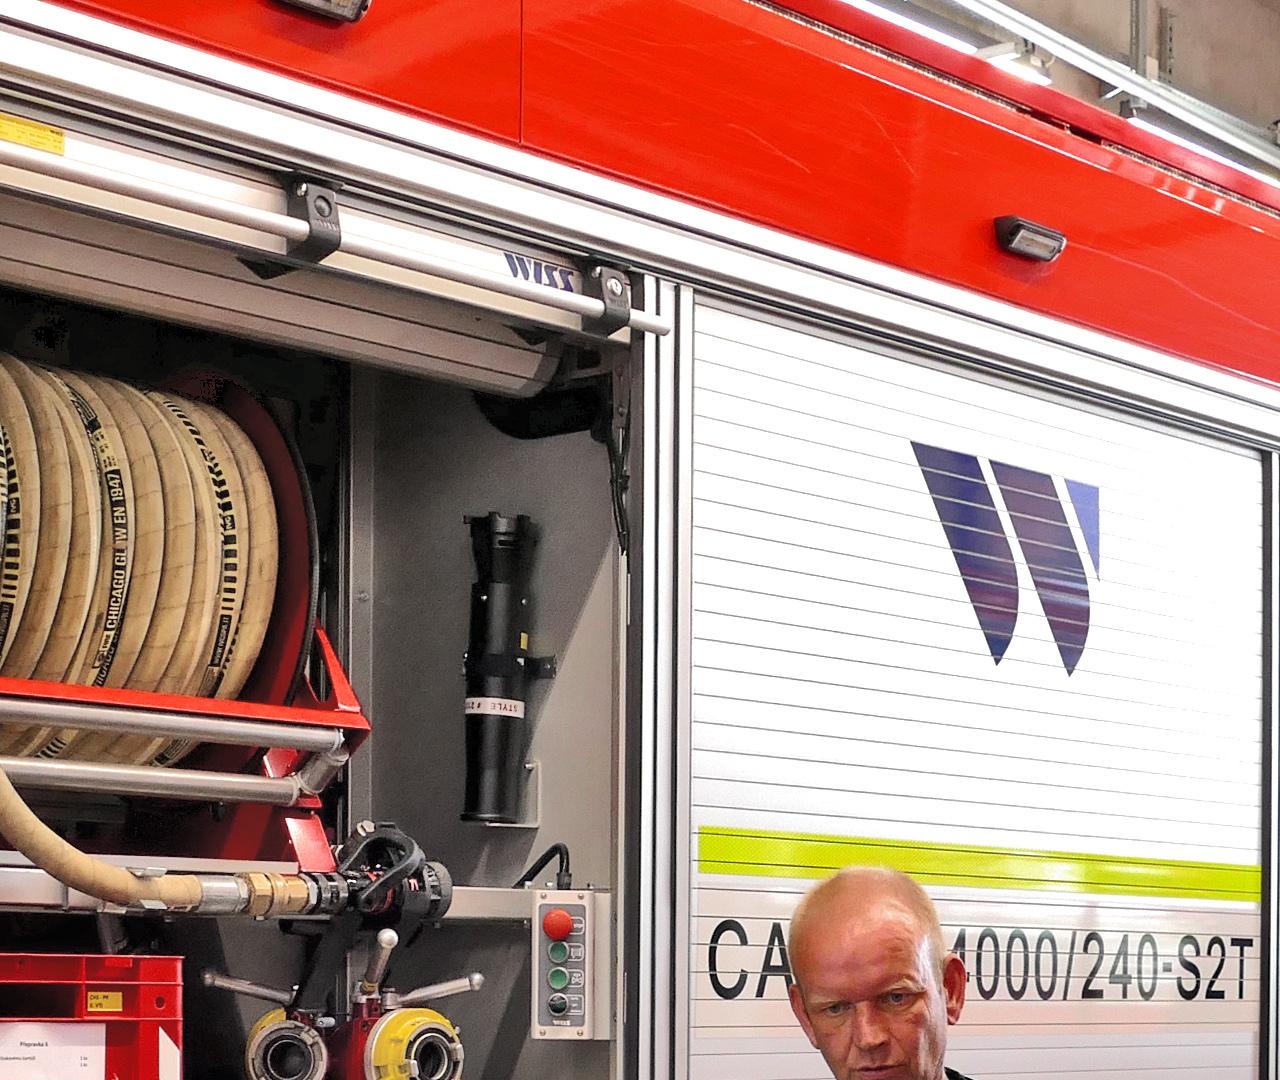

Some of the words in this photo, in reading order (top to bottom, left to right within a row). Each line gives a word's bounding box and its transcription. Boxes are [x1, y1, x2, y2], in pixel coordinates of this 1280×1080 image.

[503, 251, 575, 293] WISS
[107, 472, 124, 502] 1947
[114, 507, 127, 527] EN
[106, 570, 126, 629] CHICAGO
